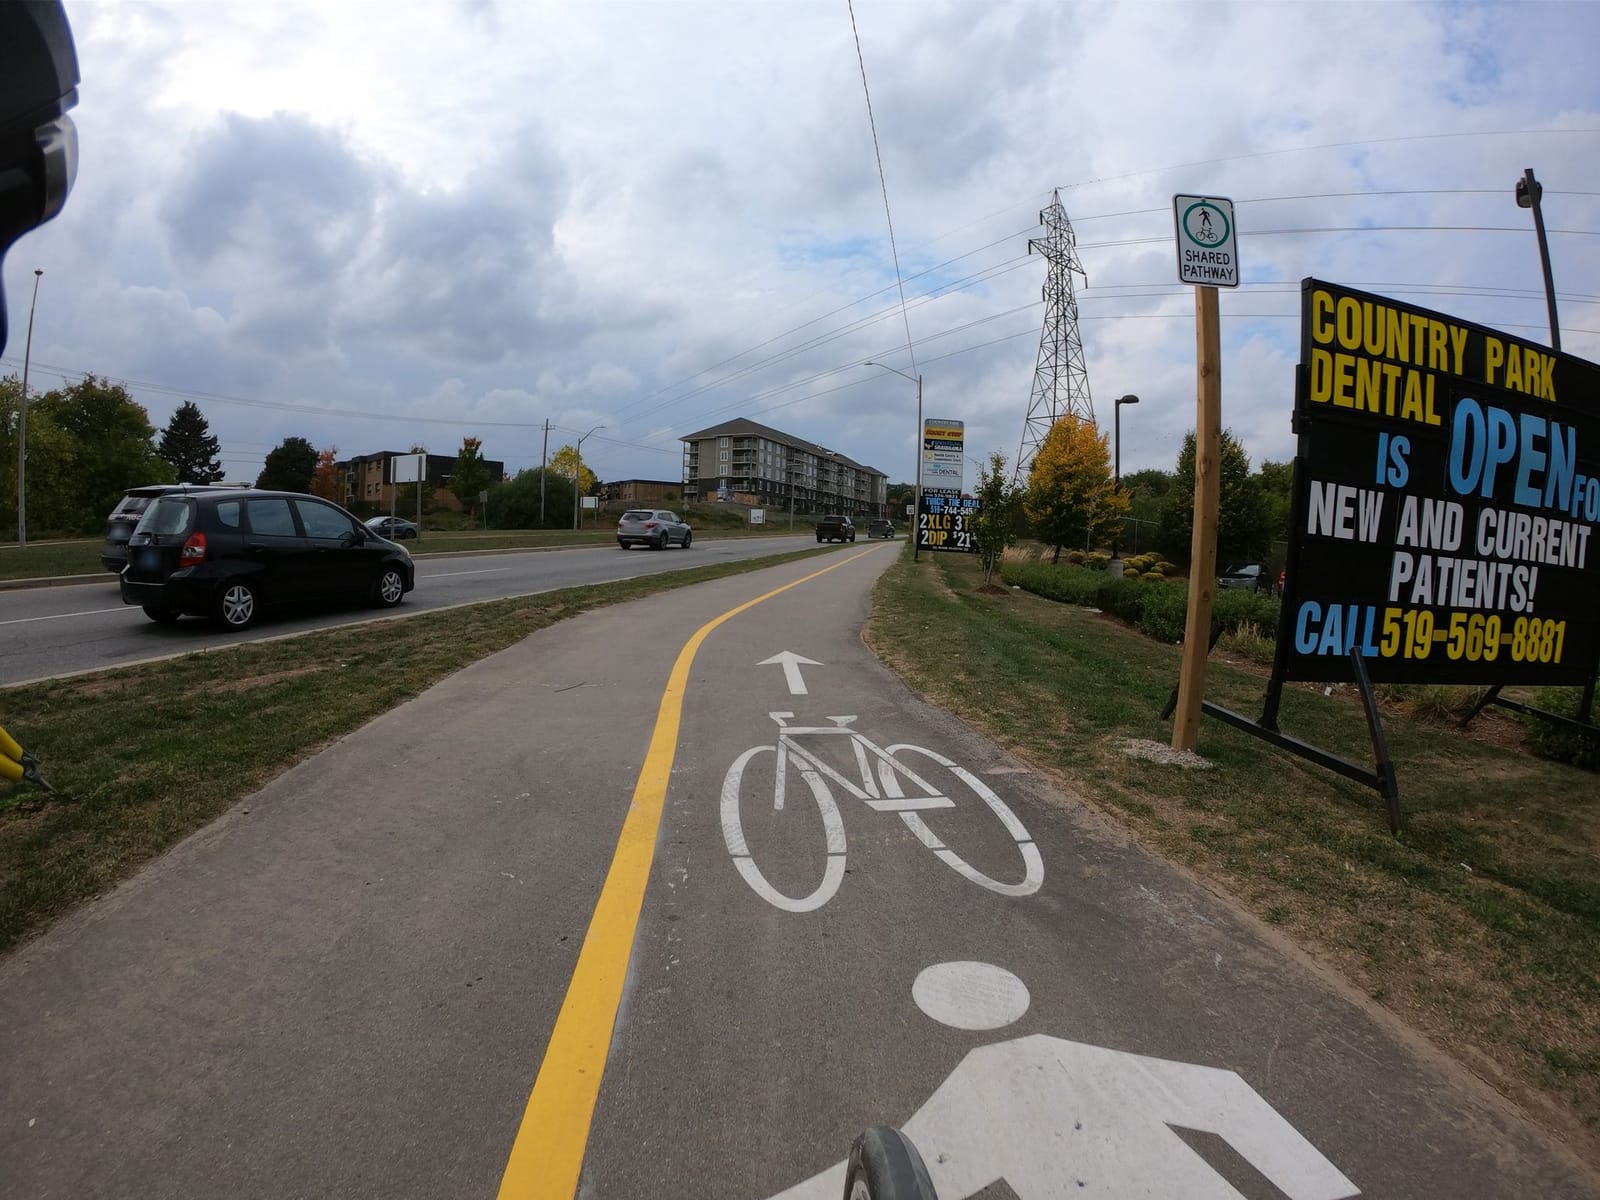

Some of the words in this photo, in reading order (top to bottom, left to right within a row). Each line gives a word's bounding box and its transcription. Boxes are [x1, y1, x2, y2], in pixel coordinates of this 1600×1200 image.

[1183, 264, 1234, 281] PATHWAY
[1185, 249, 1230, 265] SHARED
[1311, 290, 1469, 376] COUNTRY
[1486, 336, 1557, 402] PARK
[1310, 348, 1442, 426] DENTAL
[1375, 431, 1411, 488] IS
[1449, 397, 1576, 512] OPEN
[1570, 474, 1600, 523] FO
[925, 497, 945, 506] TWICE
[948, 498, 961, 507] THE
[963, 499, 980, 508] DEAL
[1306, 480, 1385, 544] NEW
[1395, 495, 1464, 552] AND
[1477, 506, 1592, 569] CURRENT
[1389, 551, 1538, 613] PATIENTS!
[1295, 600, 1380, 658] CALL
[1380, 607, 1567, 664] 519-569-8881
